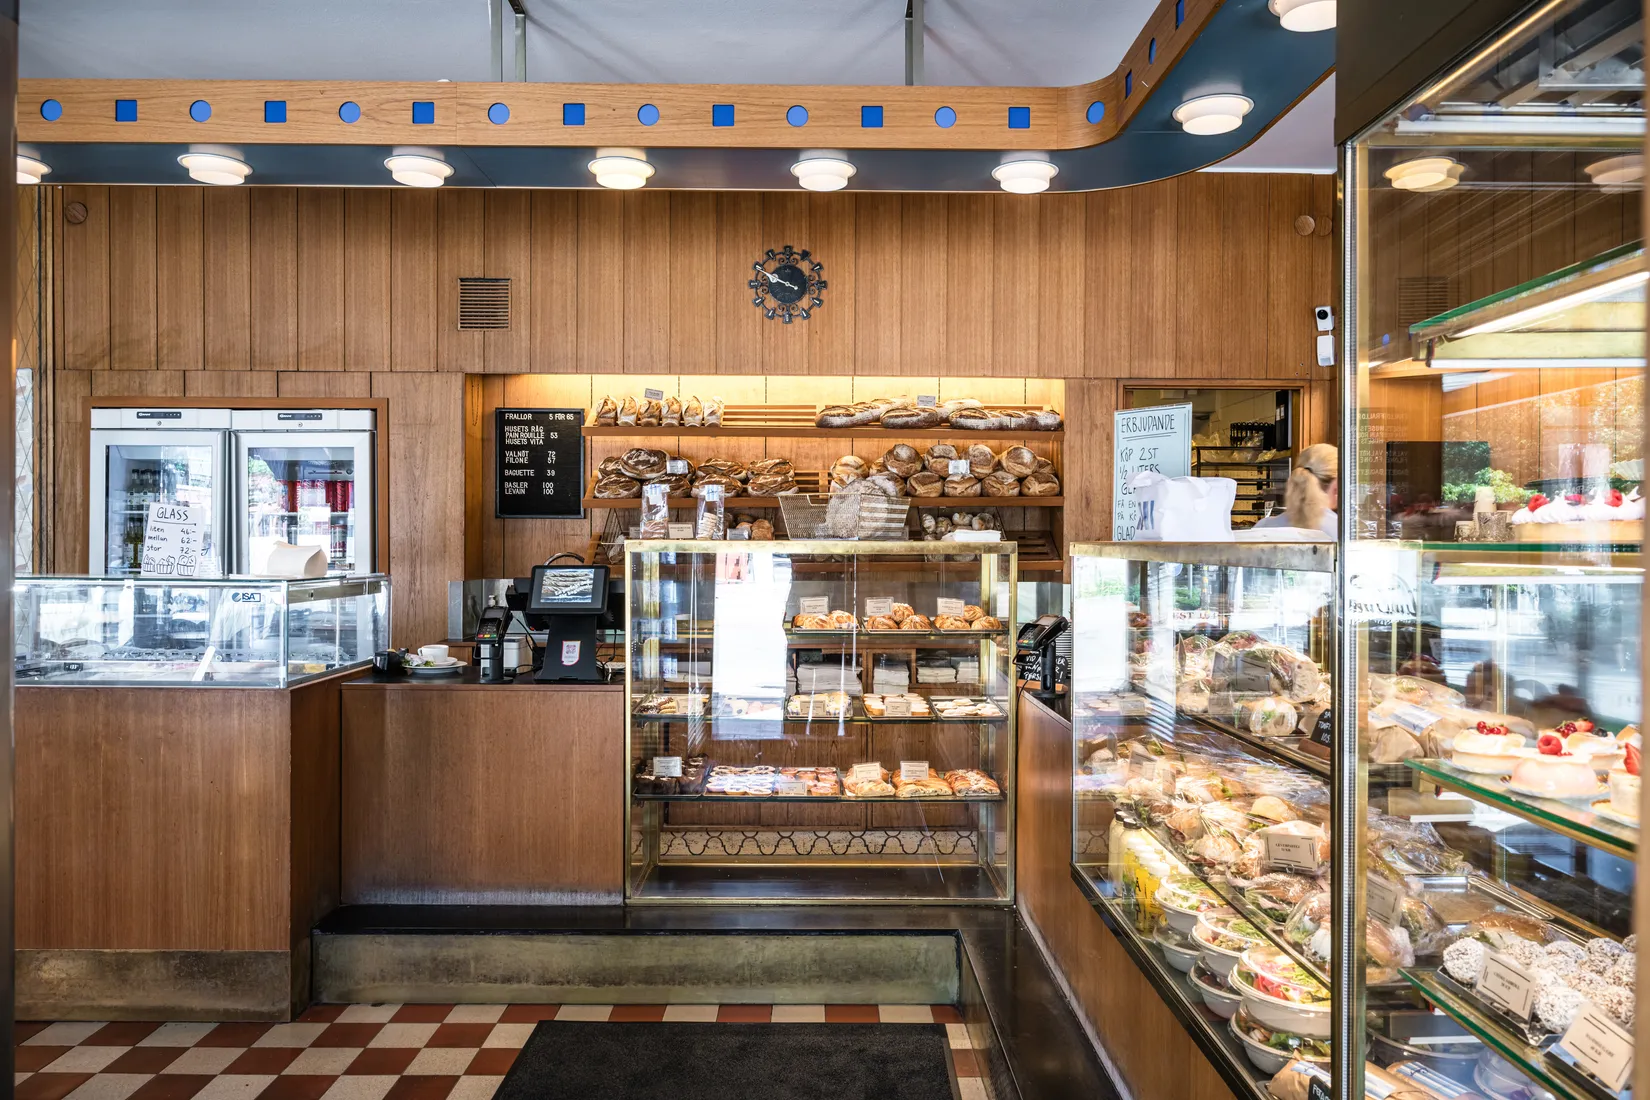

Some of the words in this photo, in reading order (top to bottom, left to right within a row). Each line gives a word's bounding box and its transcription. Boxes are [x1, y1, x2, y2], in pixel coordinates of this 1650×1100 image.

[1121, 414, 1175, 433] ERBJUDANDE
[547, 450, 556, 458] 72
[1120, 446, 1134, 463] KÖP
[504, 469, 535, 477] BAGUETTE
[546, 469, 556, 477] 39
[156, 506, 189, 521] GLASS
[1117, 525, 1136, 541] GLAD
[146, 544, 162, 552] stor
